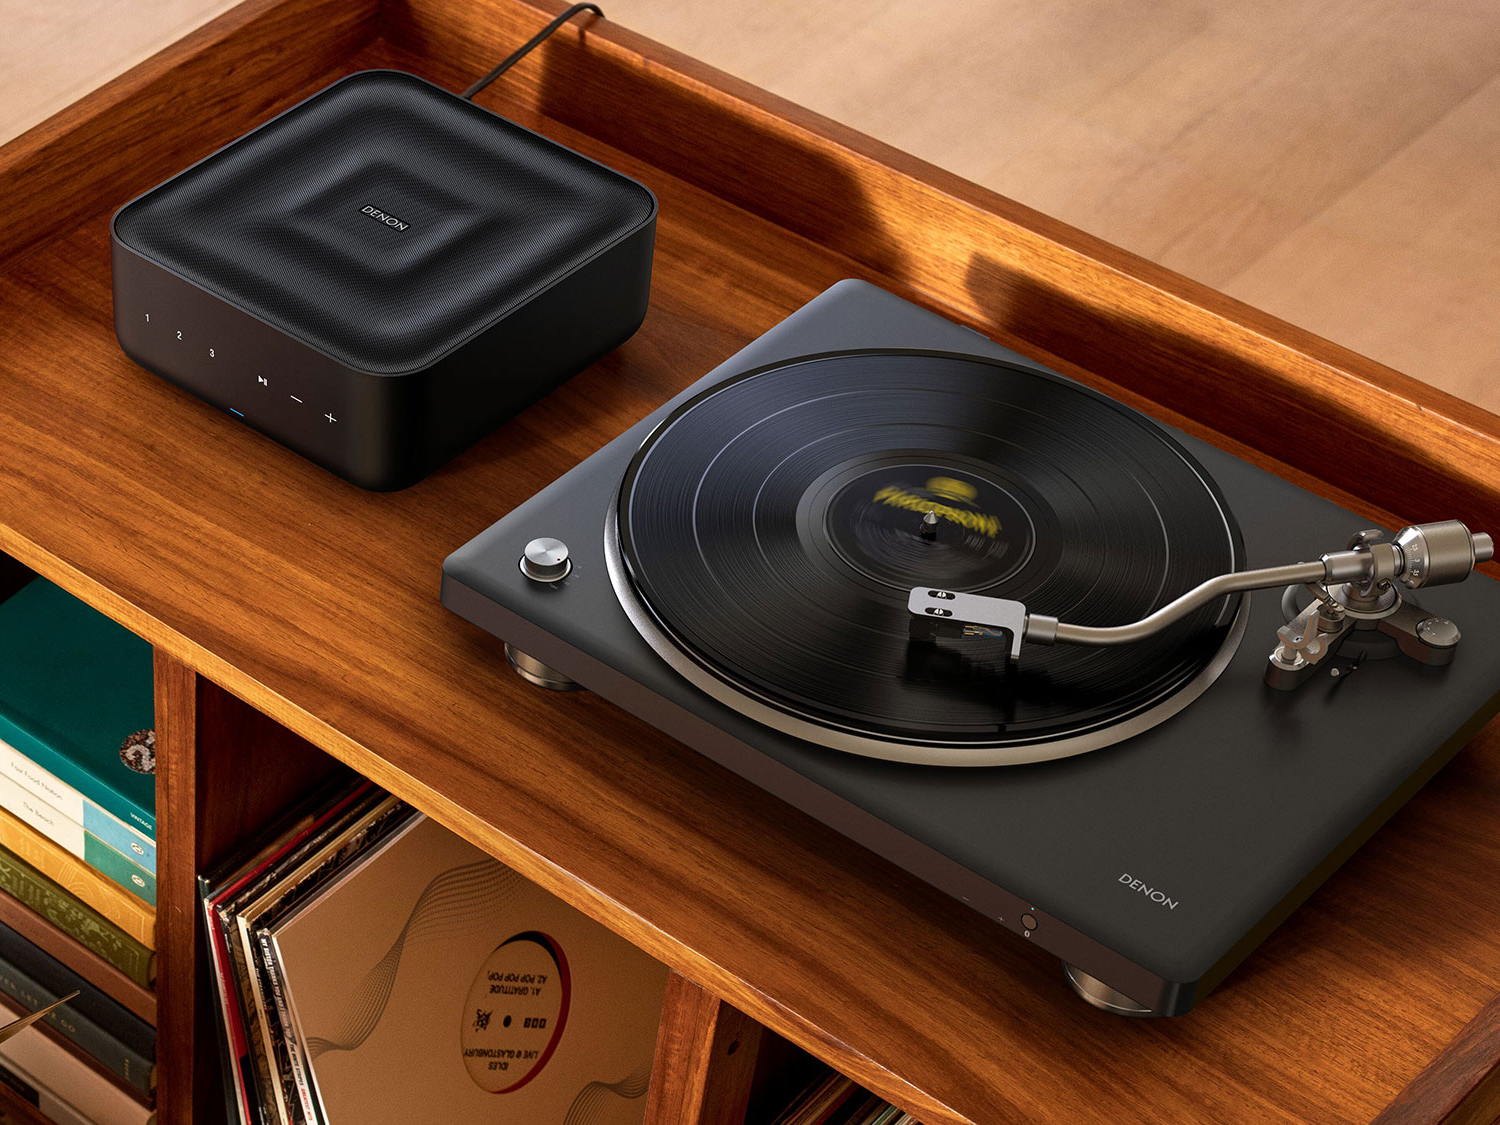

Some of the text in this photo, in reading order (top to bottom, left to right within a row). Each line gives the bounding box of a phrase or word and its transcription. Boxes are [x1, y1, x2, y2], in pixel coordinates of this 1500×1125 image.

[361, 205, 409, 231] DENON
[145, 313, 150, 323] 1
[176, 330, 182, 341] 2
[209, 348, 215, 358] 3
[130, 812, 152, 831] VINTAGE
[1118, 873, 1179, 910] DENON
[504, 973, 520, 982] POP
[520, 974, 535, 984] POP
[489, 984, 529, 995] GRATITUDE
[464, 1048, 515, 1059] GLASTONBURY
[523, 1050, 539, 1059] LIVE
[488, 1061, 509, 1071] IDLES
